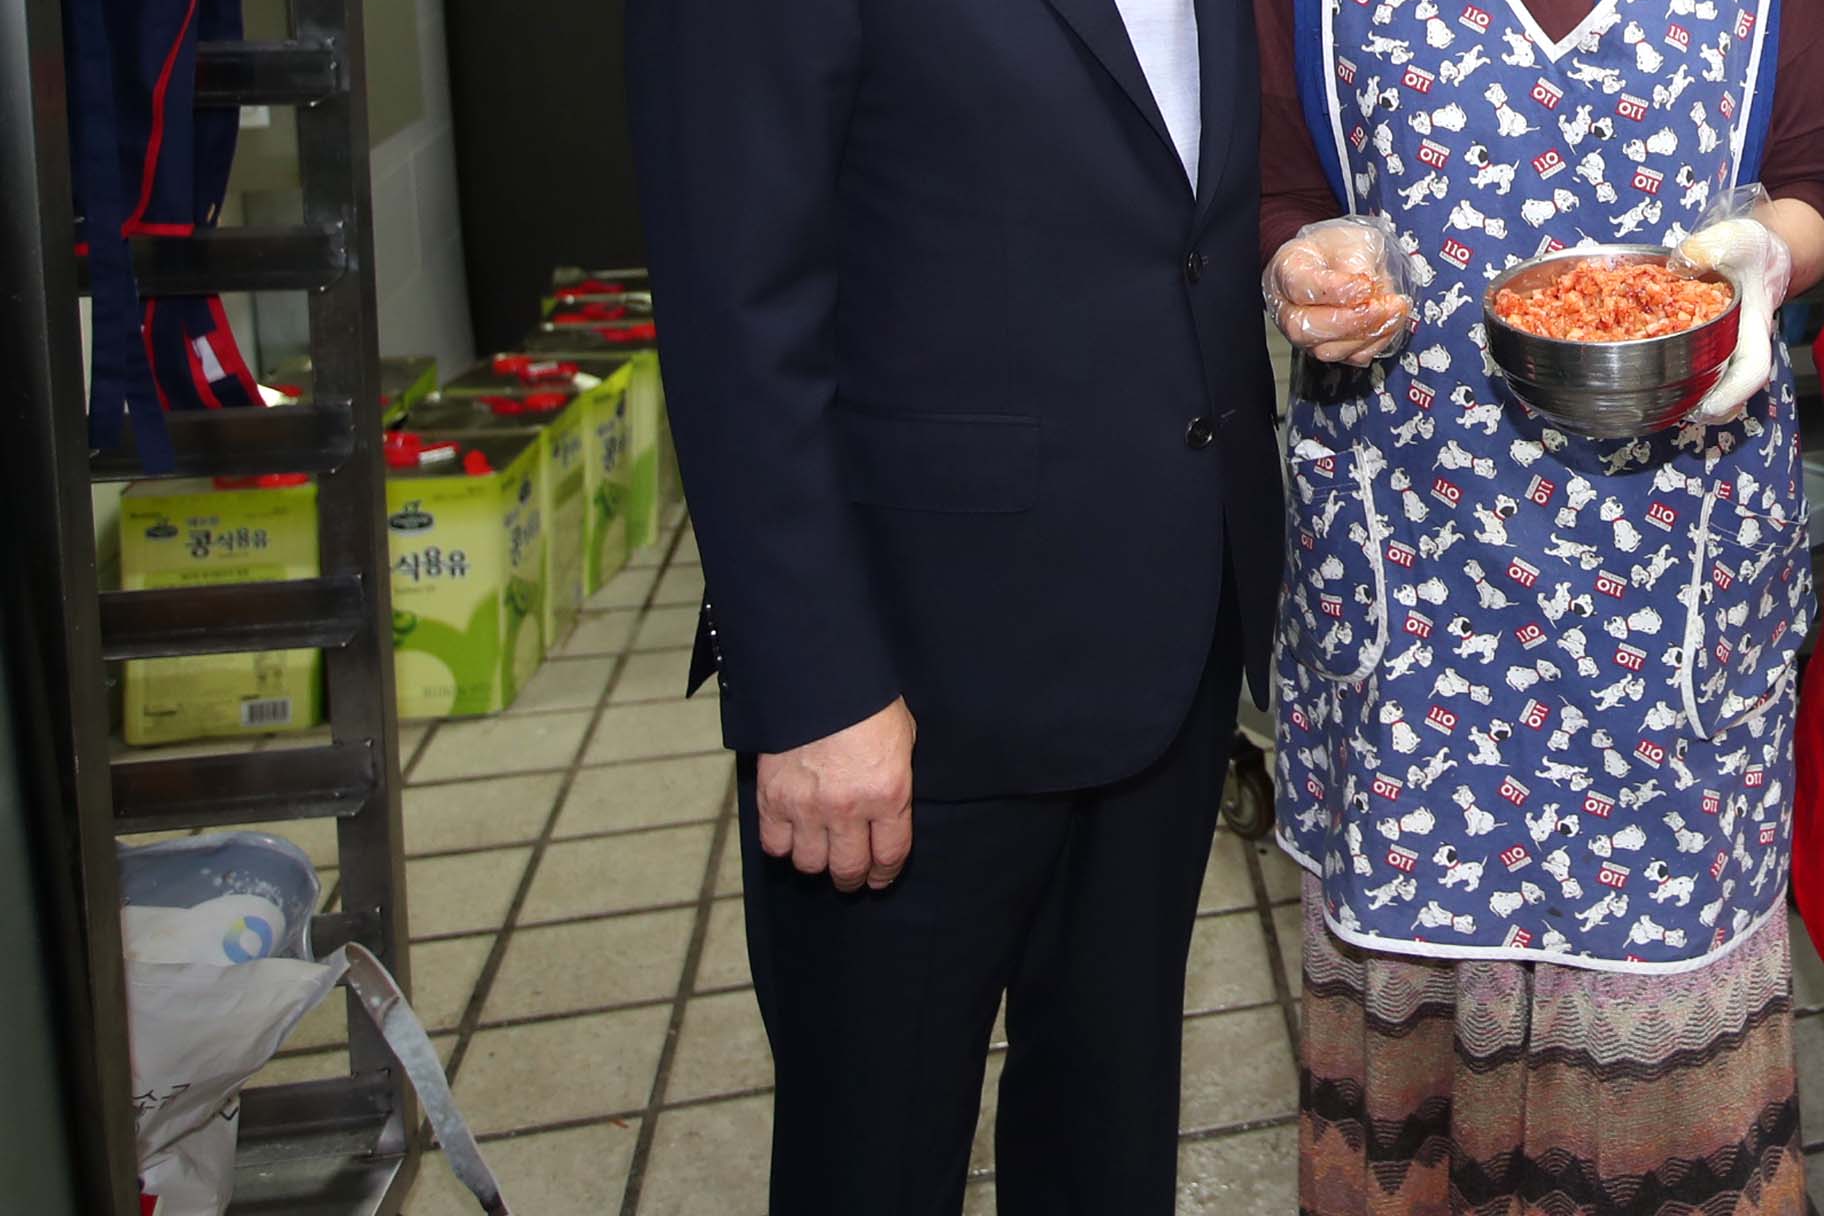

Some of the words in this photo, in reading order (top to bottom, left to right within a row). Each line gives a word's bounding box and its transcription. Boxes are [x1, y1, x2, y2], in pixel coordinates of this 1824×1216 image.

[1464, 7, 1489, 25] 110
[1669, 26, 1687, 41] 110
[1739, 14, 1753, 36] 110
[1339, 65, 1353, 83] 110
[1405, 75, 1430, 92] 110
[1533, 88, 1558, 107] 110
[1619, 102, 1644, 119] 110
[1420, 149, 1444, 168] 110
[1535, 152, 1559, 172] 110
[1635, 175, 1659, 193] 110
[1444, 241, 1470, 260] 110
[1410, 388, 1432, 408] 110
[1436, 480, 1460, 499] 110
[1535, 481, 1553, 504] 110
[1719, 484, 1730, 497] 11
[1650, 505, 1674, 522] 110
[396, 546, 470, 581] 식용유
[1388, 549, 1413, 566] 110
[1509, 566, 1535, 585] 110
[1715, 571, 1730, 588] 110
[1597, 580, 1622, 597] 110
[1324, 603, 1340, 615] 110
[1406, 619, 1429, 637] 110
[1517, 626, 1539, 641] 110
[1617, 652, 1642, 669] 110
[1430, 707, 1455, 724] 110
[1528, 705, 1548, 727] 110
[1639, 742, 1663, 760] 110
[1746, 773, 1761, 785] 110
[1374, 782, 1398, 797] 110
[1501, 785, 1524, 805] 110
[1586, 800, 1610, 816] 110
[1704, 800, 1718, 812] 110
[1761, 830, 1773, 843] 110
[1388, 854, 1414, 870] 110
[1501, 847, 1526, 864] 110
[1600, 871, 1625, 887] 110
